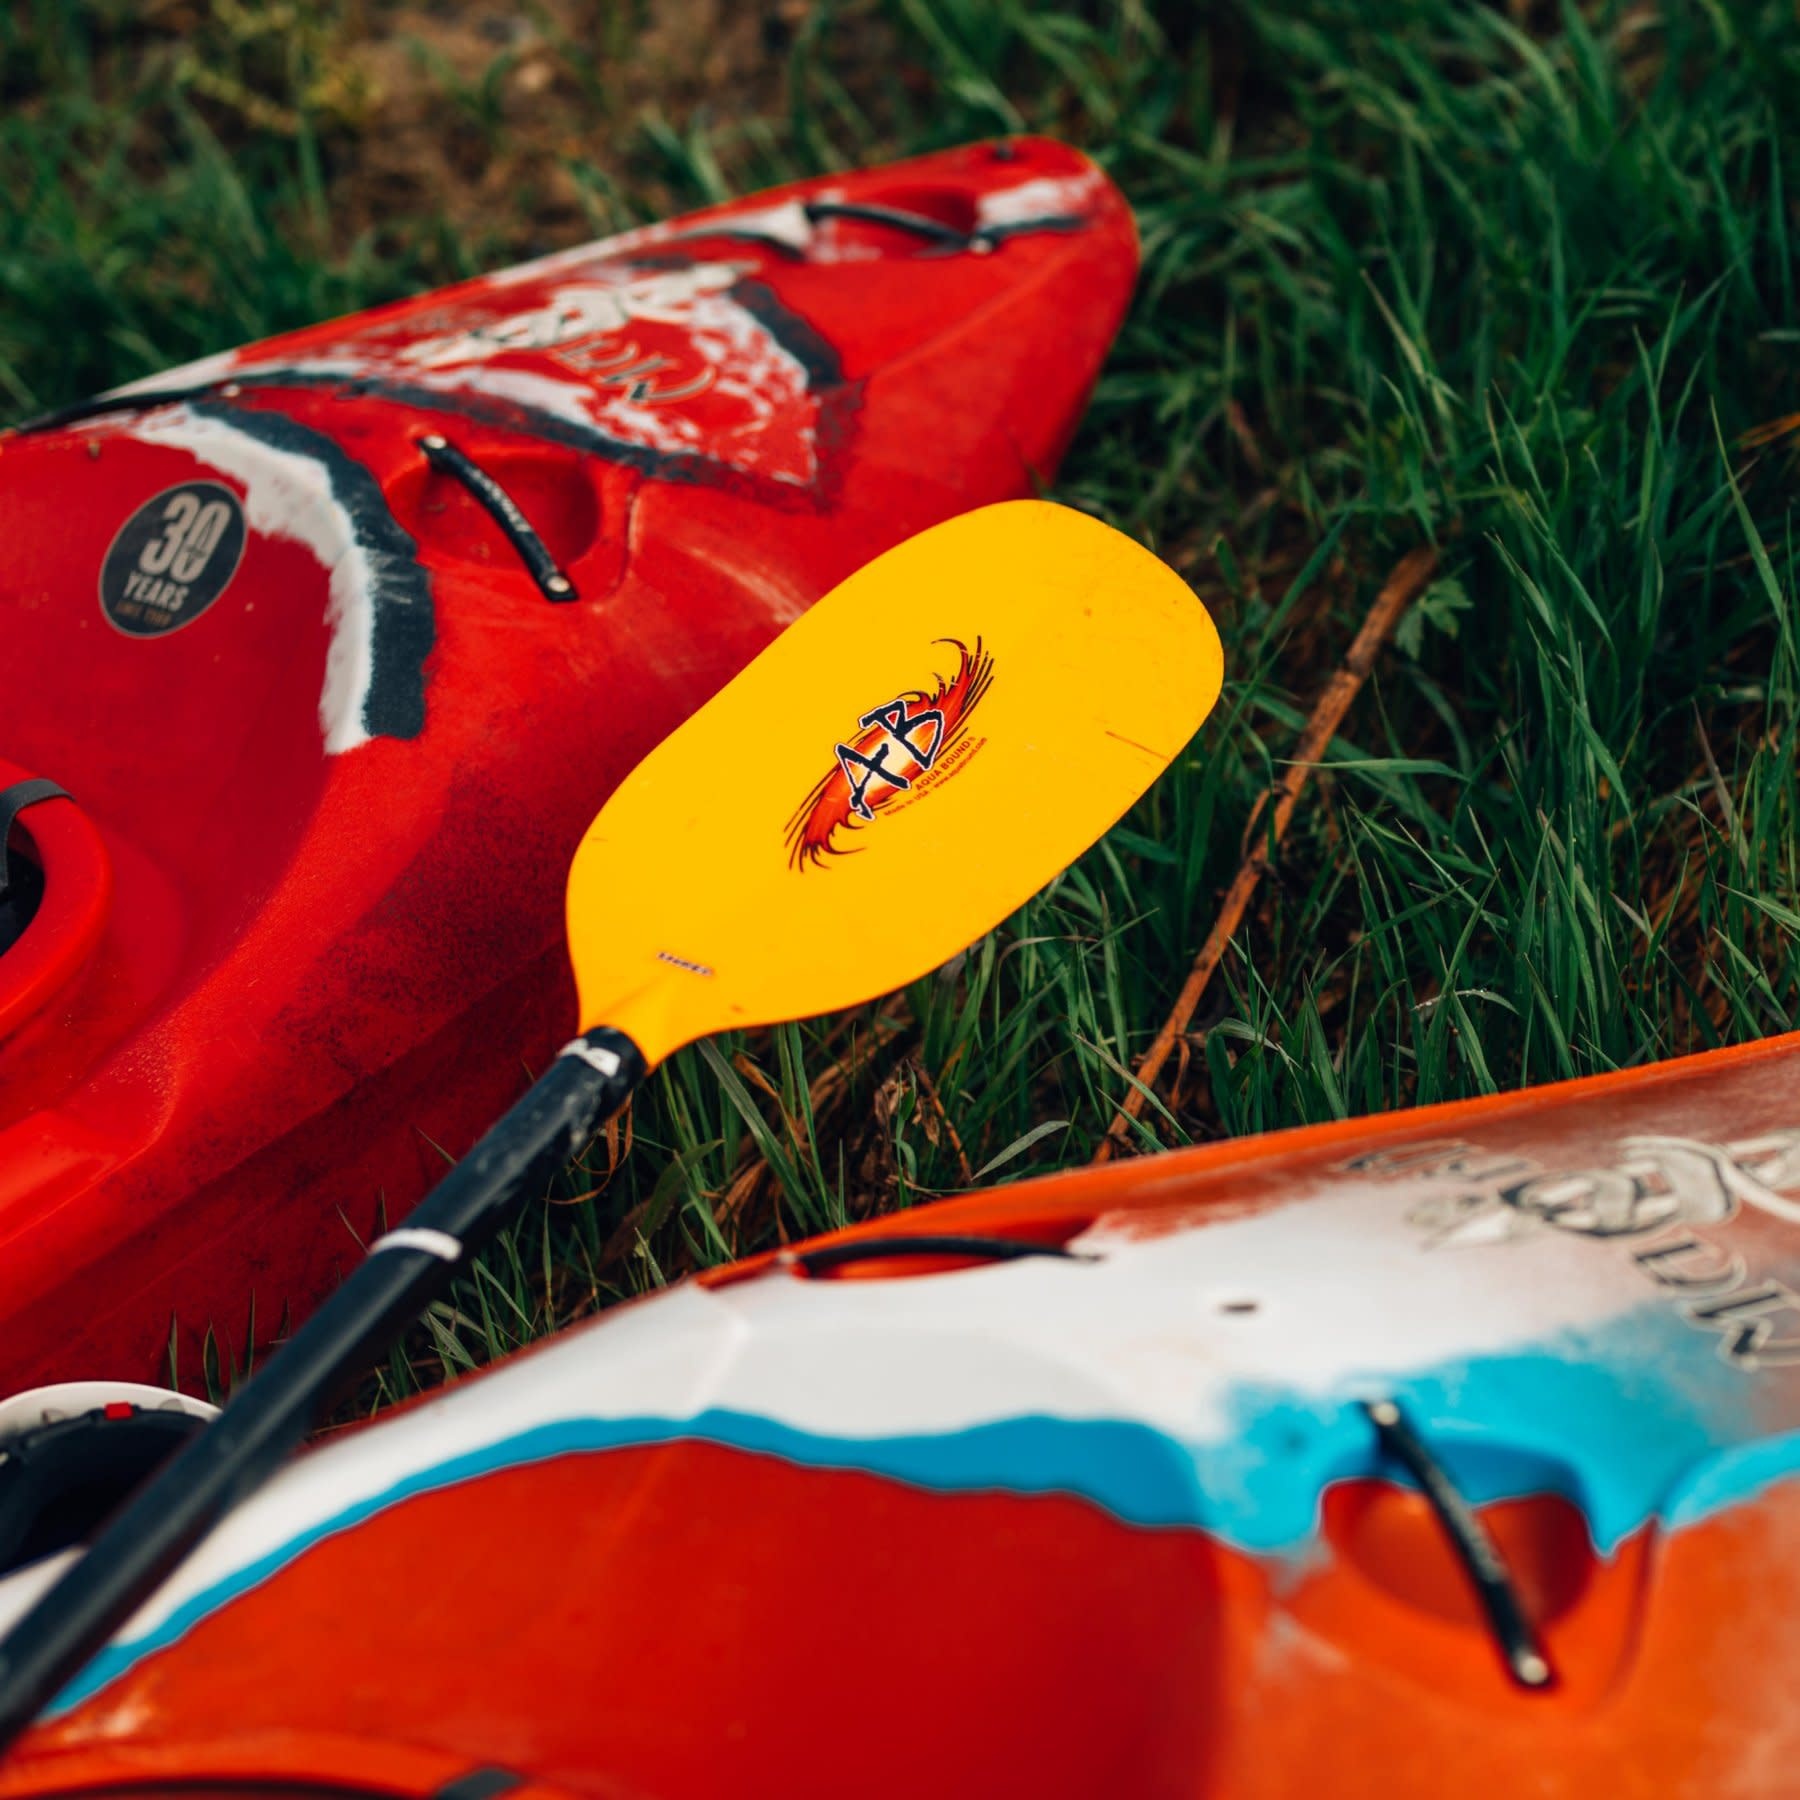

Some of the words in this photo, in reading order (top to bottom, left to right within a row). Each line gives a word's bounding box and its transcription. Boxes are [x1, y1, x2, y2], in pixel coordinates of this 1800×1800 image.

[138, 491, 231, 584] 30
[122, 569, 190, 612] YEARS
[914, 769, 942, 791] AQUA
